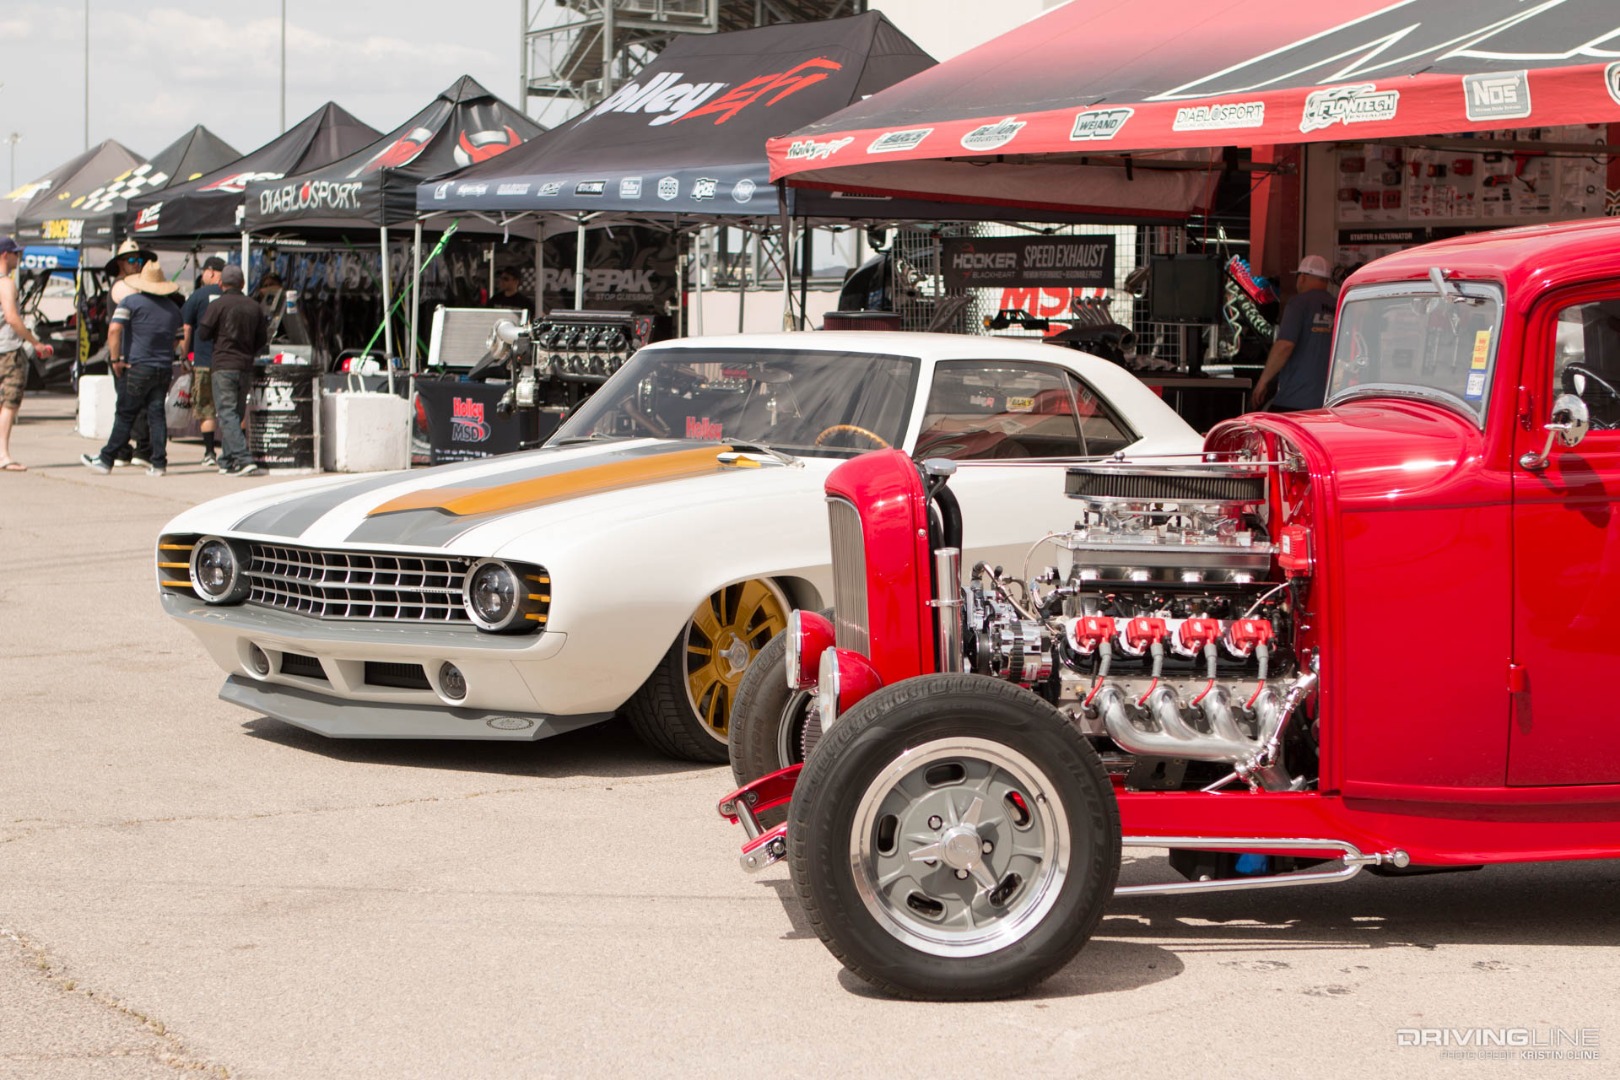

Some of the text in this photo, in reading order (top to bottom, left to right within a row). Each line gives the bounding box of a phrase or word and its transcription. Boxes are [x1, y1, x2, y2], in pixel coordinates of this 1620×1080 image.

[1472, 77, 1519, 106] NOS
[1177, 105, 1263, 123] DIABLOSPORT
[1318, 94, 1397, 117] FLOWTECH
[1080, 119, 1118, 130] WEIAND
[953, 253, 1018, 268] HOOKER
[1024, 244, 1108, 267] SPEED EXHAUST
[453, 397, 484, 424] Holley
